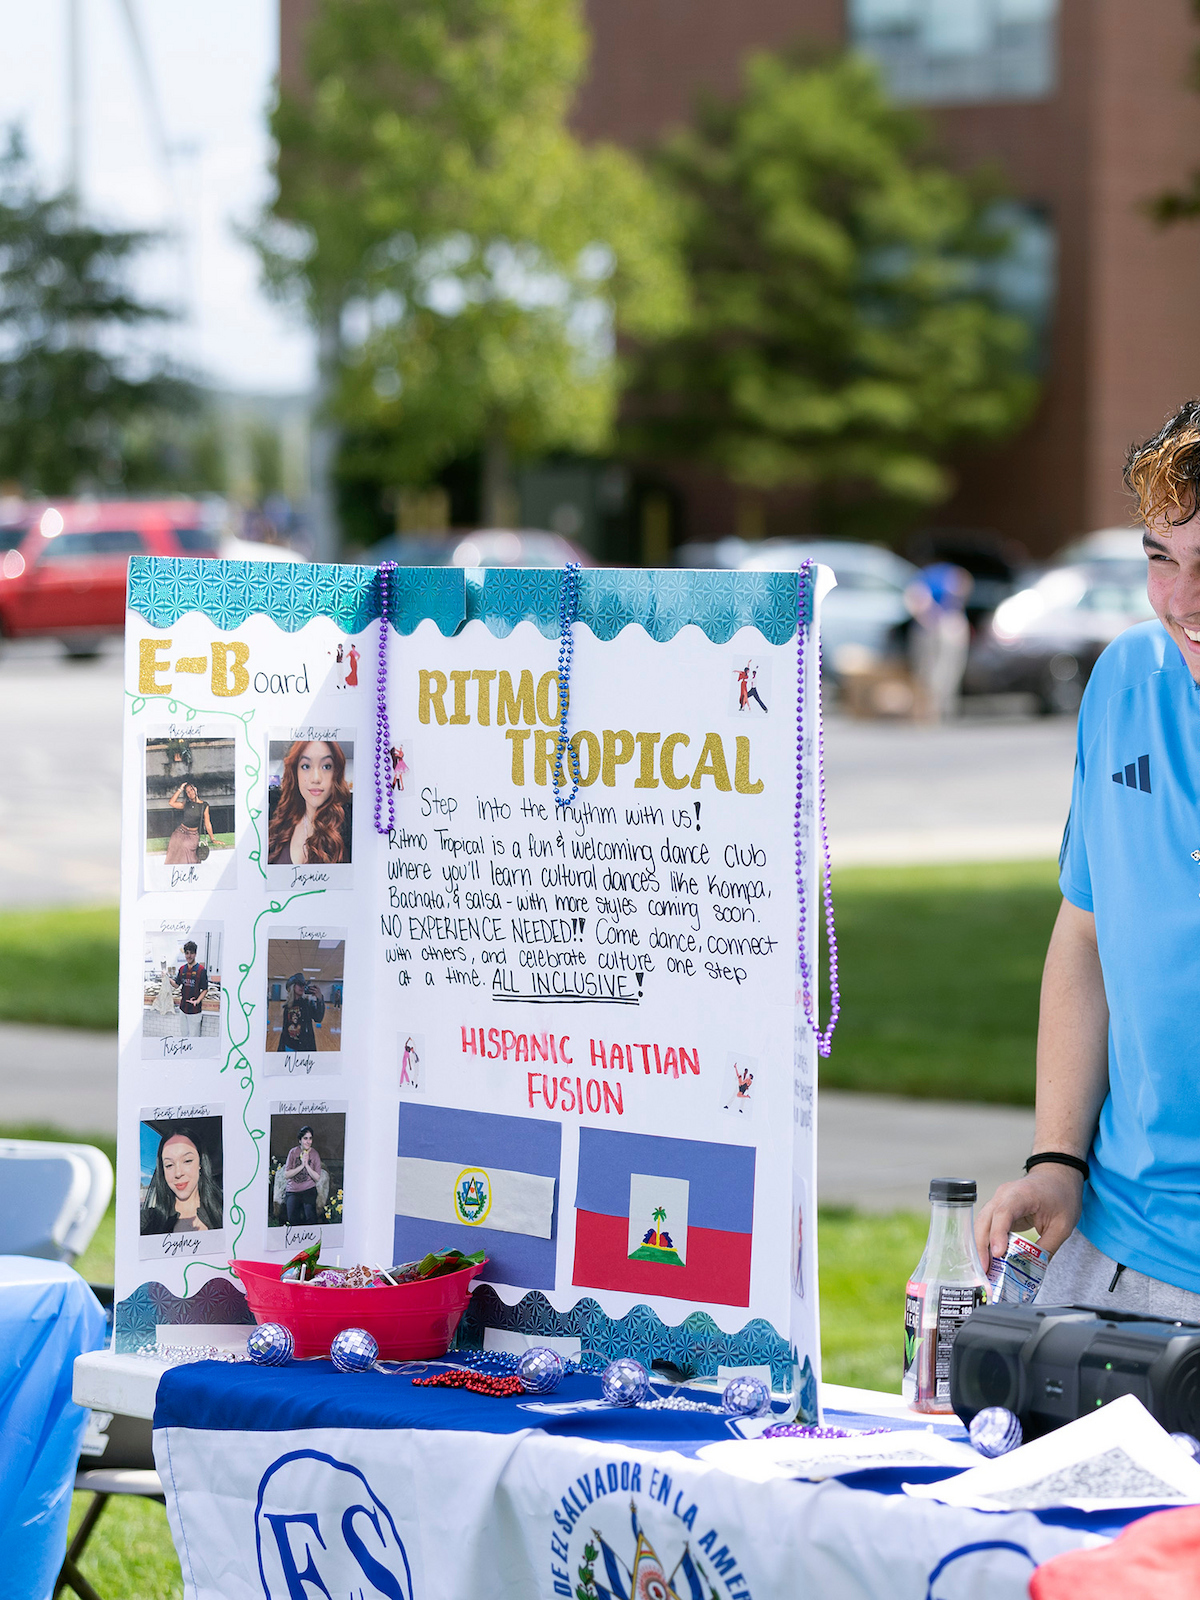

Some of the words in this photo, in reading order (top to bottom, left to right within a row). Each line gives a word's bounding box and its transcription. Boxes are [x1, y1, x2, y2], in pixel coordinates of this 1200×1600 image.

[138, 638, 310, 697] E-Board
[418, 669, 570, 727] RITMO
[505, 729, 765, 794] TROPICAL
[421, 787, 458, 821] Step
[476, 796, 511, 822] into
[520, 797, 548, 820] the
[626, 803, 664, 825] with
[672, 802, 701, 831] us!
[388, 827, 428, 850] Ritmo
[434, 829, 485, 858] Tropical
[492, 835, 505, 855] is
[512, 842, 521, 859] a
[528, 833, 553, 858] fun
[556, 830, 566, 859] &
[572, 837, 656, 875] welcoming
[661, 837, 710, 864] dance
[442, 860, 480, 894] you'll
[490, 860, 532, 887] learn
[541, 863, 597, 890] cultural
[602, 867, 660, 892] dances
[670, 870, 699, 895] like
[388, 885, 450, 910] Bachata,
[452, 883, 460, 909] &
[465, 889, 502, 910] salsa
[517, 889, 548, 913] with
[555, 894, 590, 913] more
[595, 896, 637, 924] styles
[648, 896, 700, 932] coming
[712, 904, 761, 923] soon.
[380, 914, 402, 939] NO
[409, 915, 507, 942] EXPERIENCE
[511, 917, 586, 944] NEEDED!!
[595, 917, 640, 945] Come
[649, 927, 702, 953] dance,
[707, 935, 779, 956] connect
[385, 943, 412, 964] with
[481, 947, 507, 965] and
[519, 949, 587, 969] celebrate
[598, 950, 655, 972] culture
[667, 956, 696, 977] one
[398, 969, 412, 987] at
[425, 971, 435, 986] a
[445, 966, 486, 987] time.
[492, 968, 520, 993] ALL
[532, 971, 644, 997] INCLUSIVE!
[285, 1053, 315, 1074] Wendy
[460, 1025, 574, 1064] HISPANIC
[590, 1039, 701, 1079] HAITIAN
[527, 1072, 624, 1115] FUSION
[162, 1233, 201, 1255] Sydney
[1024, 1279, 1036, 1290] 160
[906, 1298, 920, 1316] PURE
[906, 1312, 920, 1329] LEAF
[940, 1307, 960, 1315] Calories
[960, 1306, 973, 1315] 160
[554, 1461, 641, 1535] SALVADOR
[649, 1467, 672, 1506] EN
[673, 1490, 699, 1532] LA
[551, 1531, 569, 1564] EL
